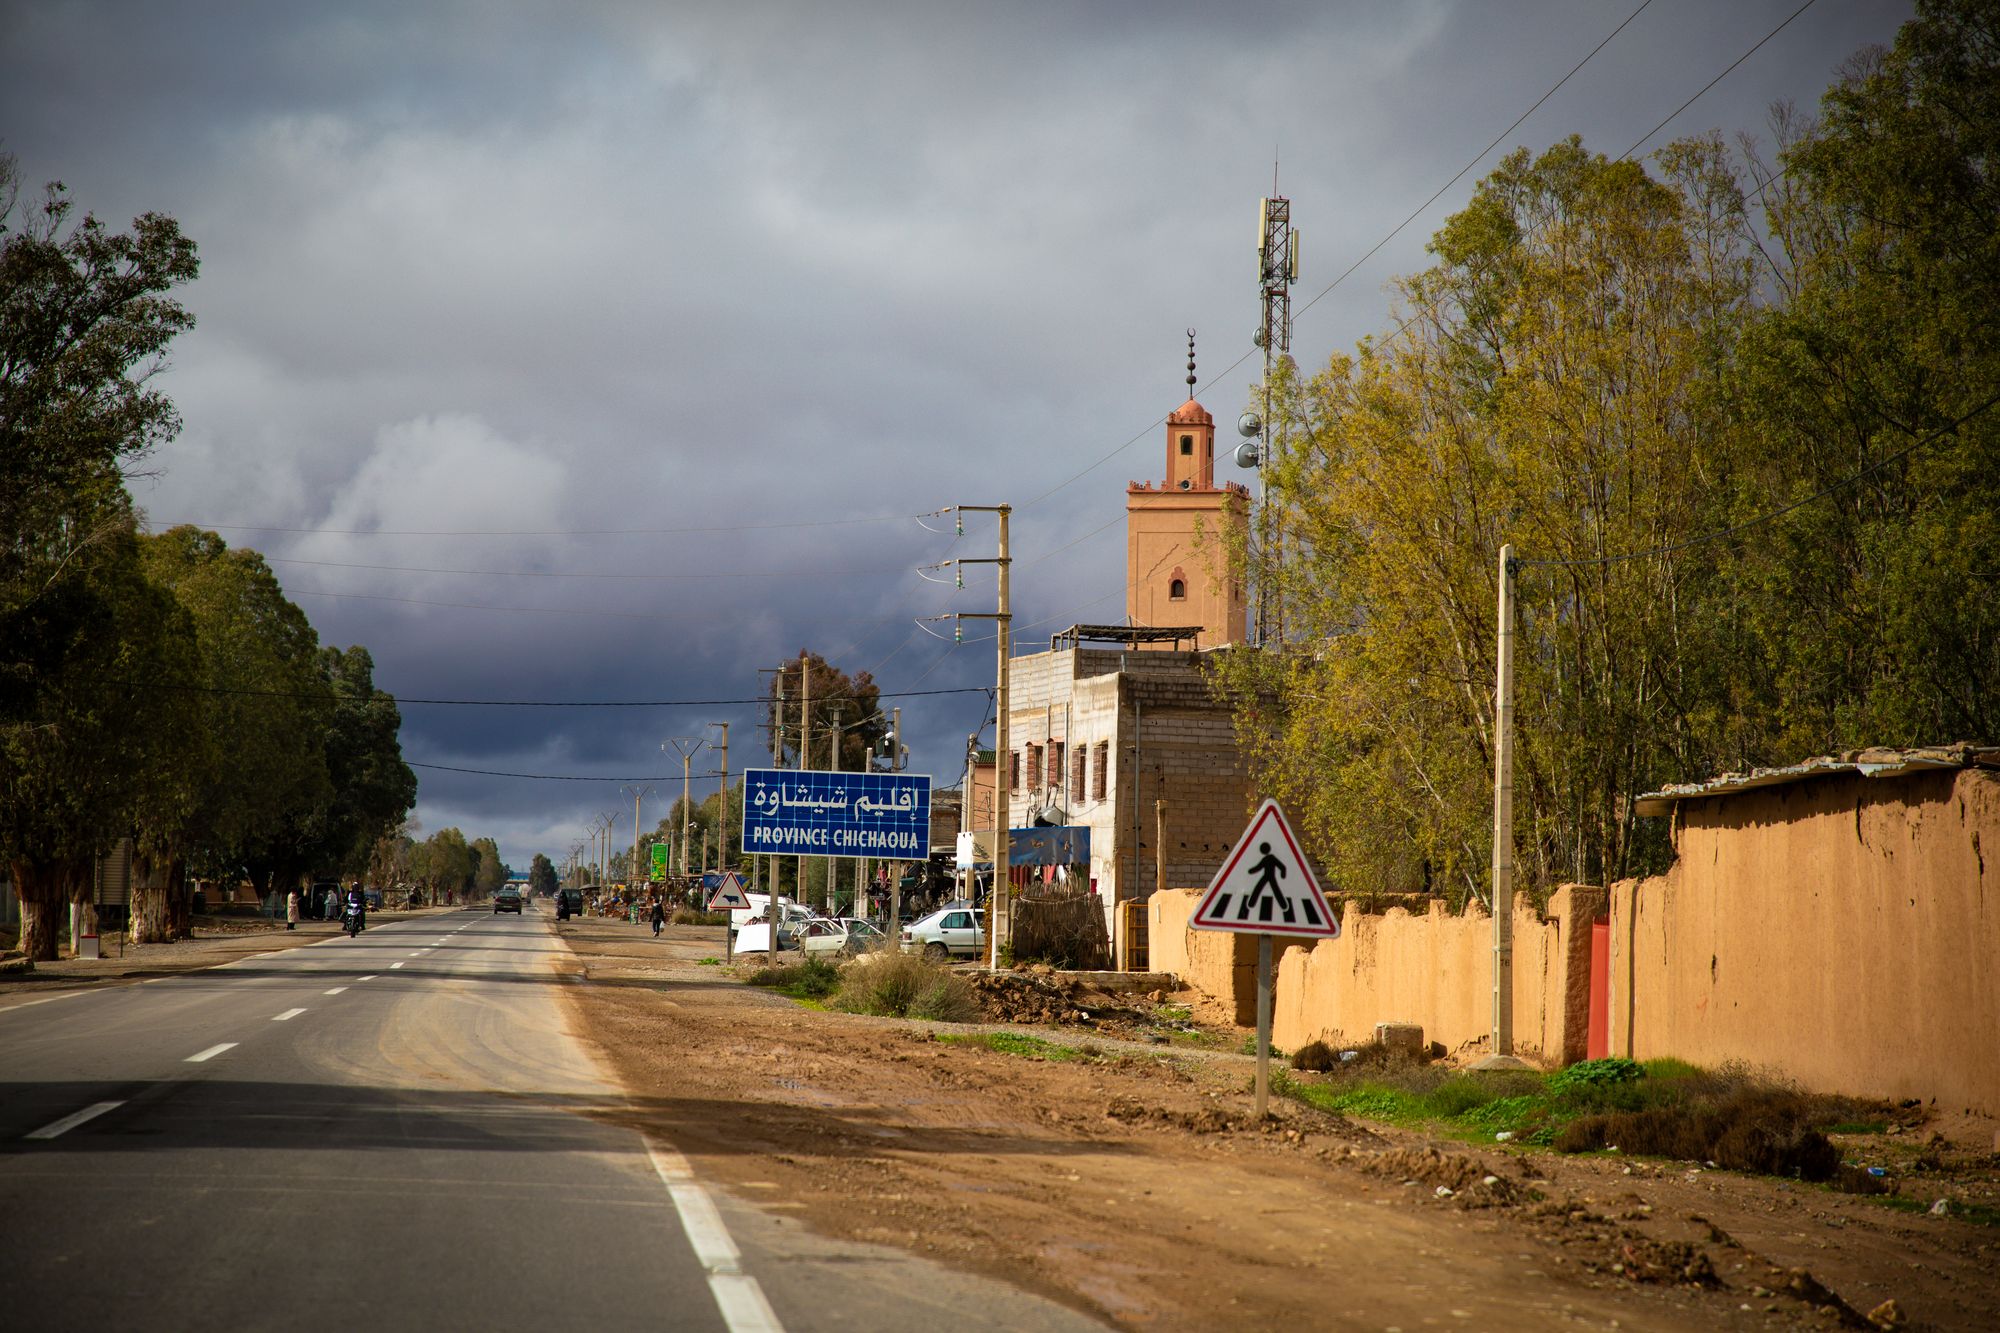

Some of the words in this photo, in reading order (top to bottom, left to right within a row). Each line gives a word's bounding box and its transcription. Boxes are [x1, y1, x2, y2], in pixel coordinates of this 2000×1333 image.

[754, 781, 848, 816] شيشاوة
[854, 786, 919, 822] إقليم
[753, 826, 828, 846] PROVINCE
[833, 829, 918, 849] CHICHAOUA
